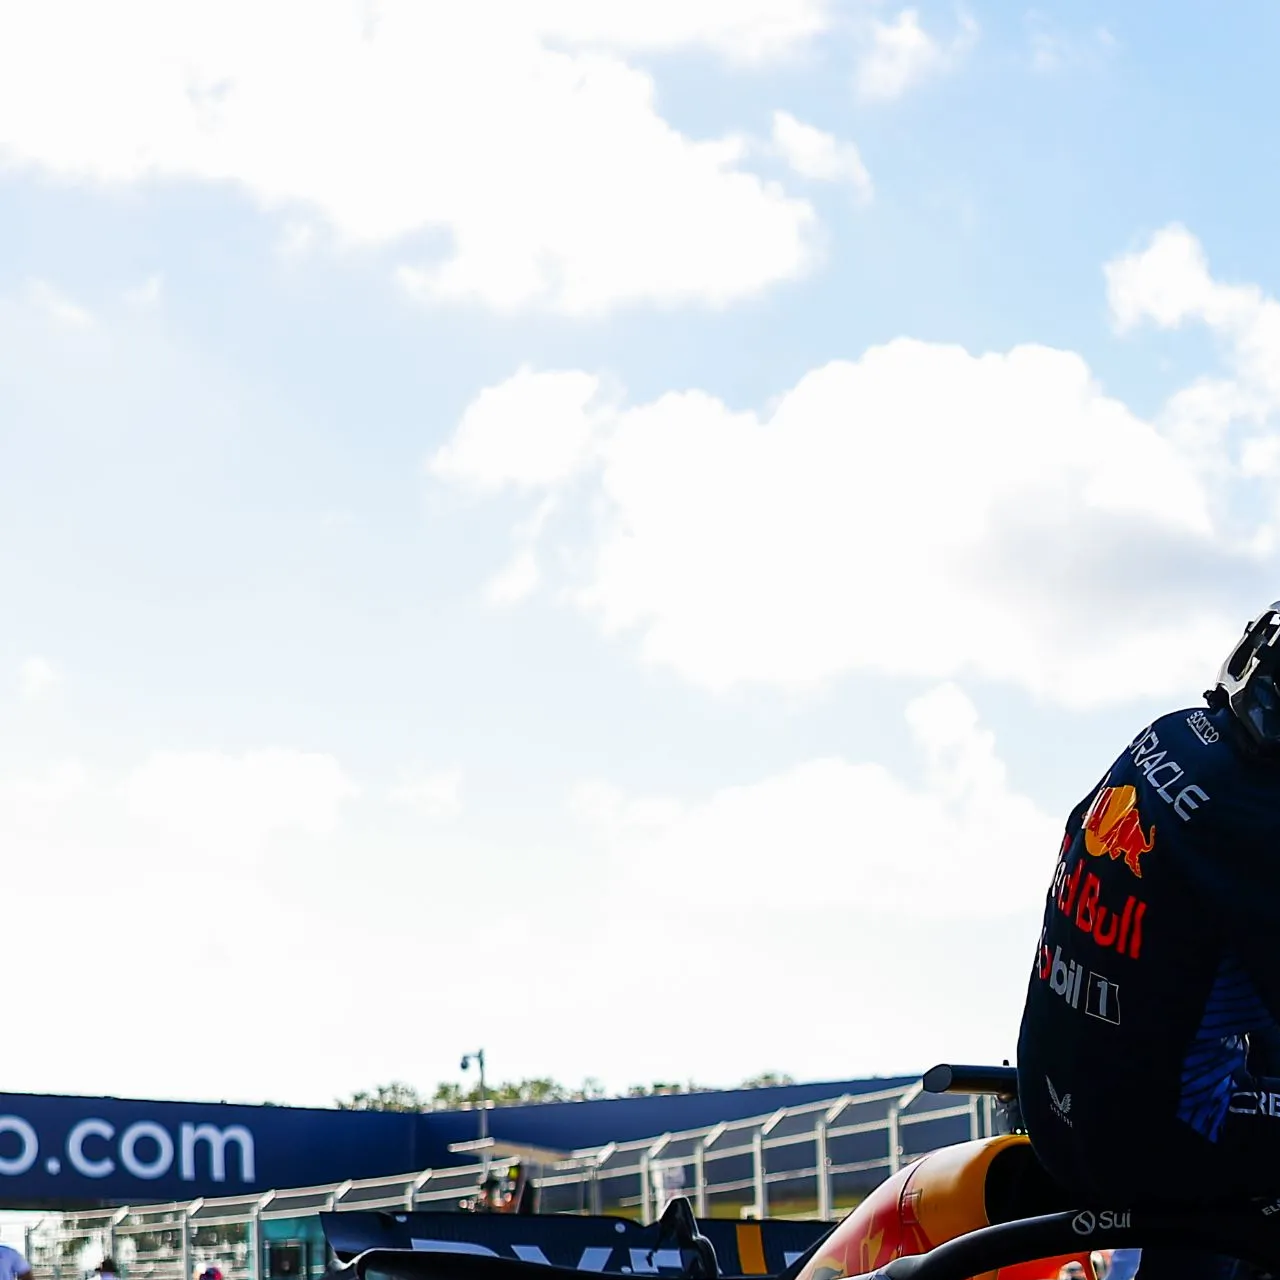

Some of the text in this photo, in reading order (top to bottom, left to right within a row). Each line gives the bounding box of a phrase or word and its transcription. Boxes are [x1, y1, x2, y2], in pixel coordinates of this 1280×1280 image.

[1186, 710, 1220, 746] sparco
[1074, 872, 1148, 960] Bull
[1098, 1207, 1132, 1230] Sui
